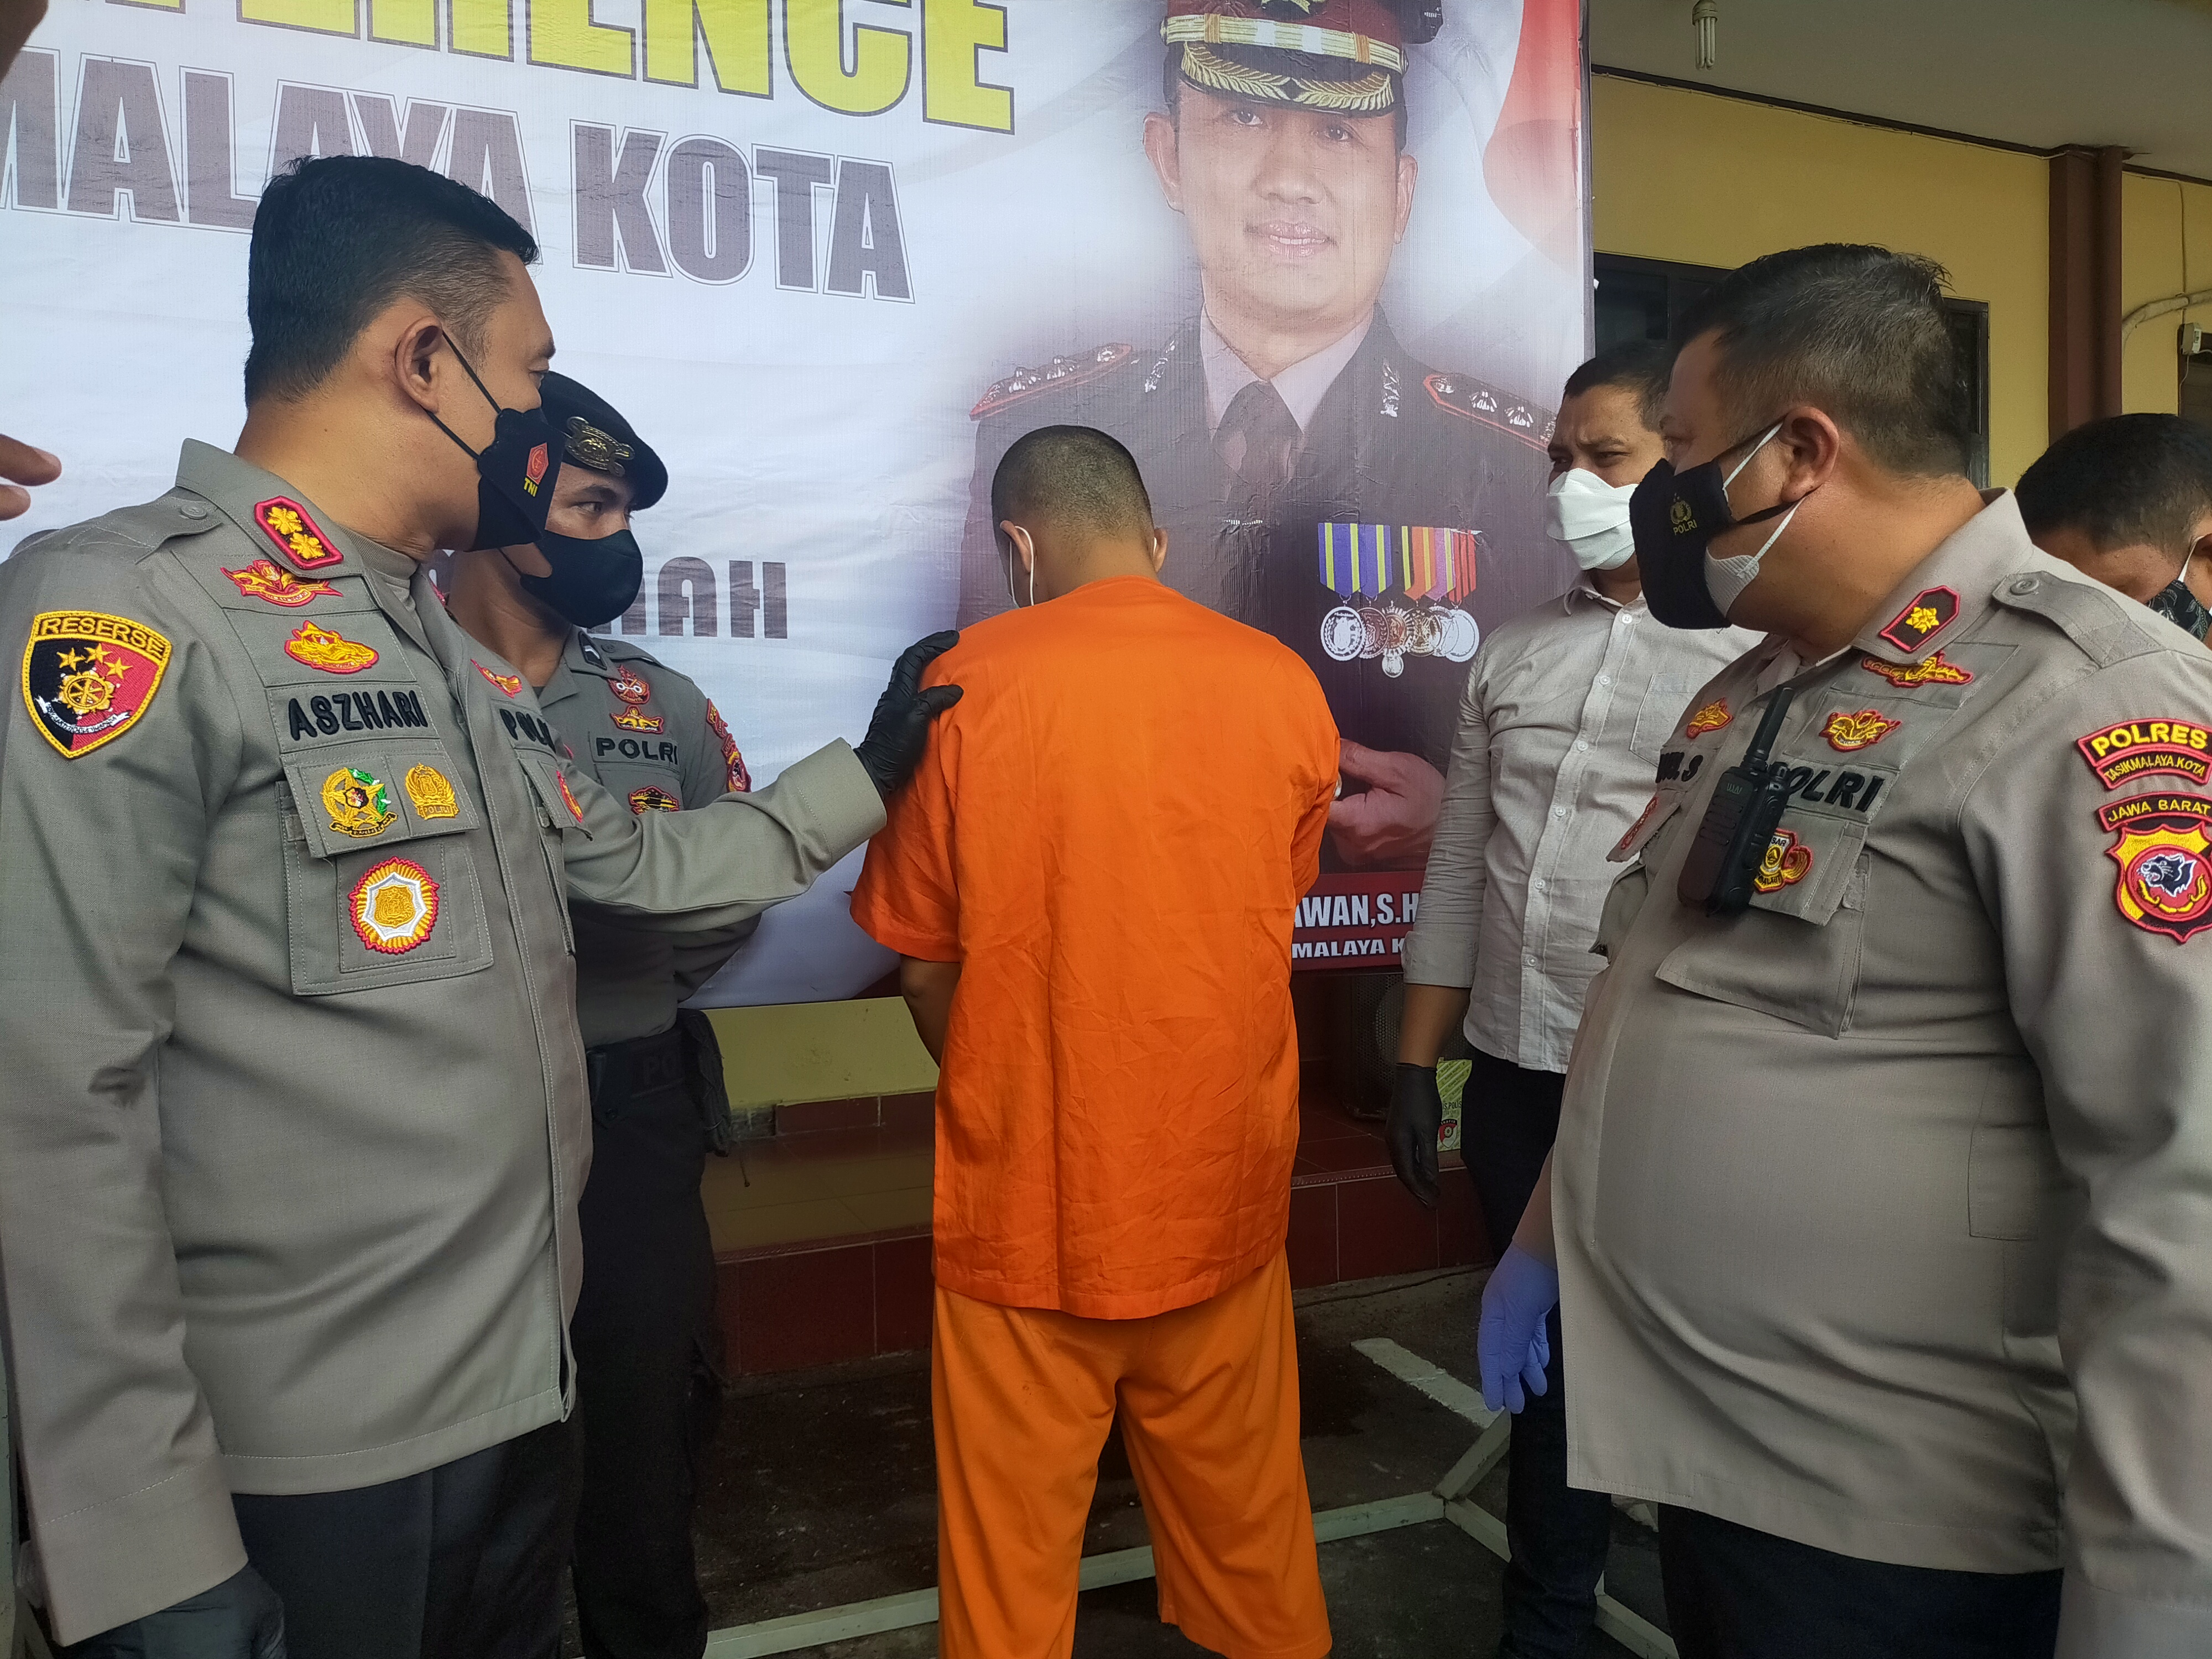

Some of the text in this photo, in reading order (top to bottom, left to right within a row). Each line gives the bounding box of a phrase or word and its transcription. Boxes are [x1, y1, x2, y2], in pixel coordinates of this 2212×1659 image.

[570, 119, 915, 304] KOTA
[523, 477, 538, 497] TNI
[1673, 519, 1697, 535] POLRI
[41, 617, 166, 659] RESERSE
[289, 690, 428, 741] ASZHARI
[596, 737, 678, 765] POLRI
[2091, 723, 2208, 757] POLRES
[2104, 755, 2206, 781] TASIKMALAYA KOTA
[1788, 766, 1885, 812] OLRI
[423, 805, 450, 815] POLRI
[2109, 800, 2211, 822] JAWA BARAT
[1292, 939, 1385, 958] MALAYA
